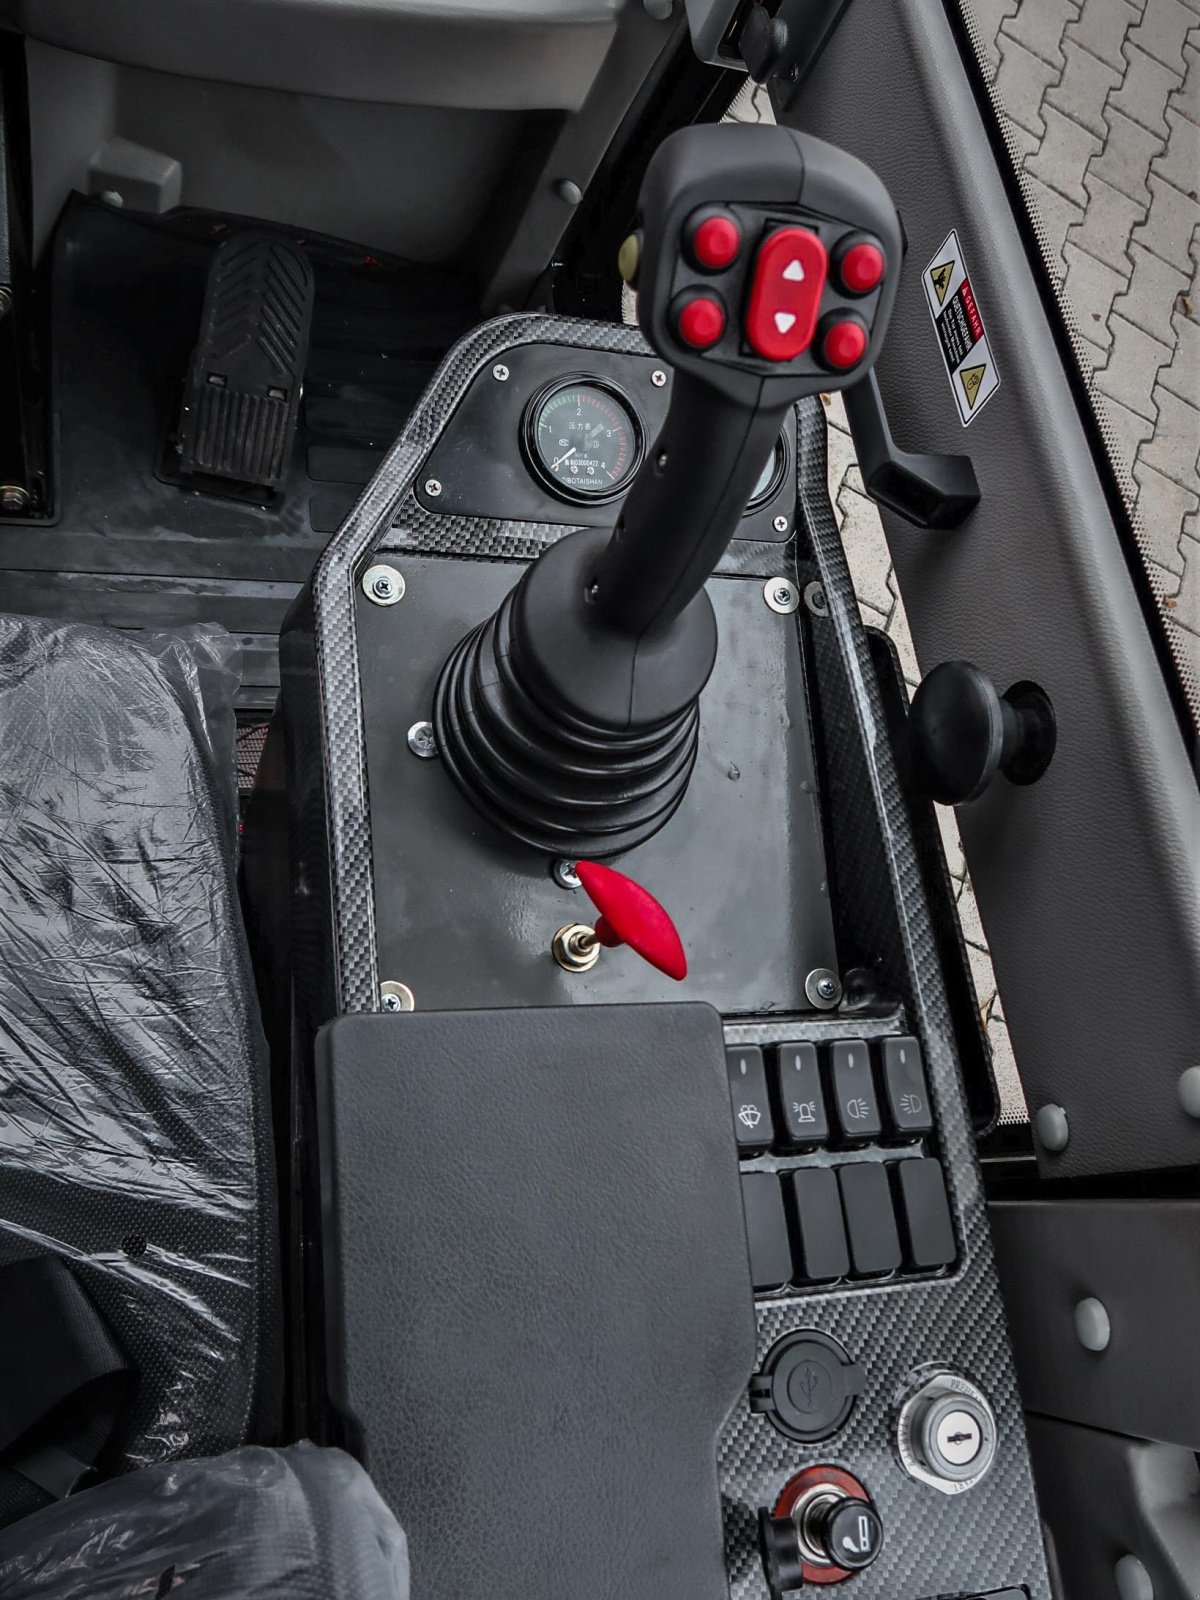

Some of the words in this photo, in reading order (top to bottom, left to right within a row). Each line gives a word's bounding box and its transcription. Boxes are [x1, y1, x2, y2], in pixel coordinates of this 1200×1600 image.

[965, 295, 981, 335] GEFAHR
[576, 407, 582, 416] 2
[606, 429, 612, 438] 3
[600, 461, 606, 470] 4
